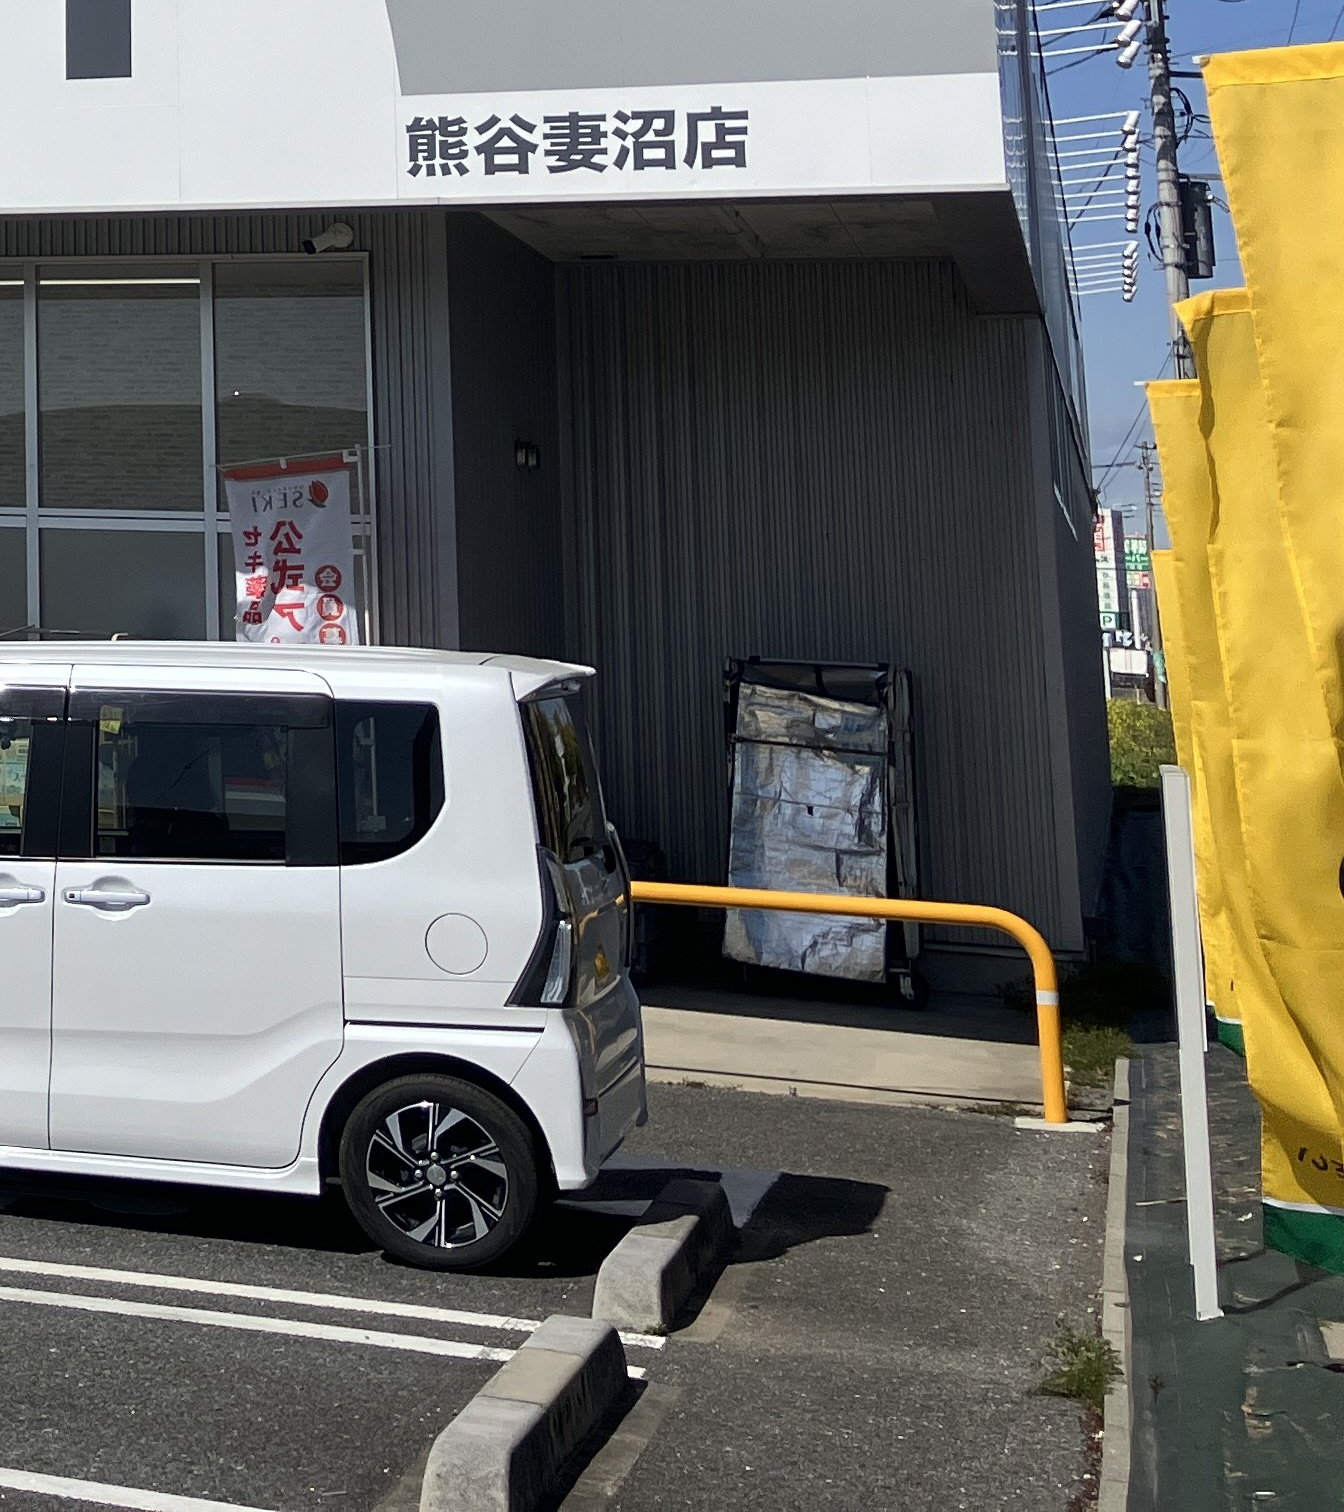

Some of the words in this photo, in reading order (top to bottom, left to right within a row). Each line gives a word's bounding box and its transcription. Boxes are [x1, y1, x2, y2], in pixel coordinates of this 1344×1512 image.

[405, 105, 749, 178] 熊谷妻沼店
